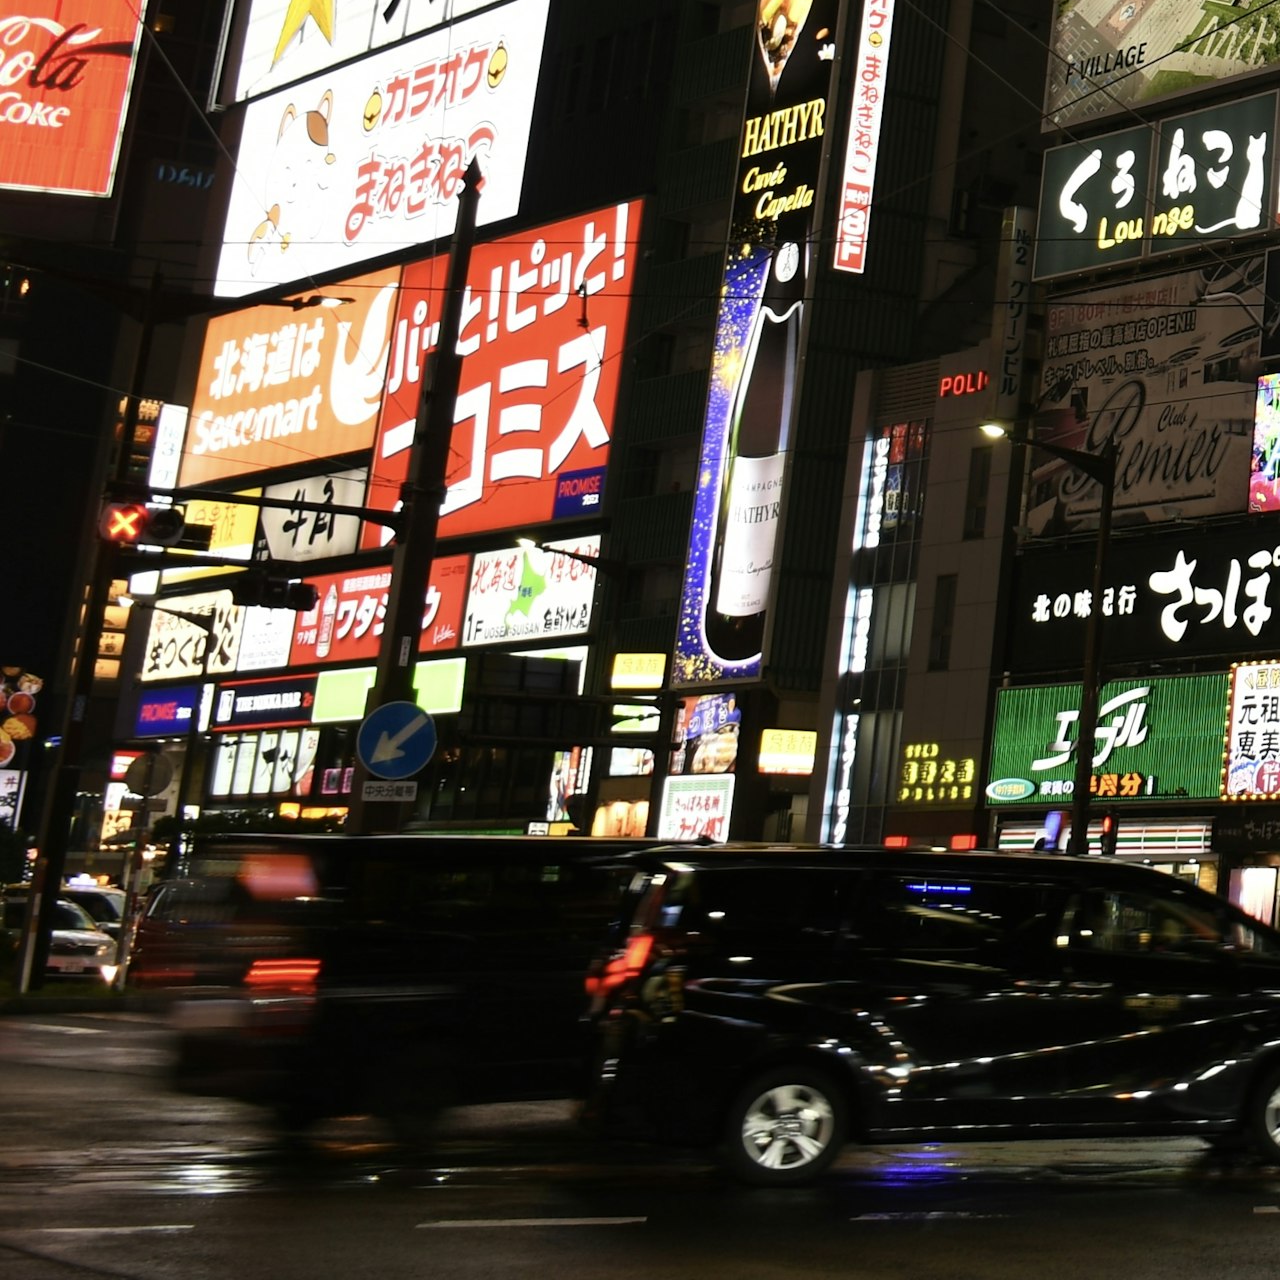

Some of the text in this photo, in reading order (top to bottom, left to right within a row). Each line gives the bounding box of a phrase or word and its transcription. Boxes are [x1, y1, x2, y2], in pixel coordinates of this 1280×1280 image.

[381, 47, 489, 121] カラオケ
[1064, 43, 1148, 85] F VILLAGE
[742, 97, 826, 158] HATHYR
[851, 54, 882, 174] まねきねこ
[742, 161, 787, 194] Cuvée
[755, 183, 814, 221] Capella
[210, 317, 324, 401] 北海道は
[191, 386, 321, 455] Seicomart
[1158, 402, 1190, 432] Club
[558, 477, 601, 498] PROMISE
[283, 479, 336, 549] 牛角
[472, 554, 519, 596] 北海道
[467, 613, 484, 641] 1F
[140, 701, 178, 721] PROMISE
